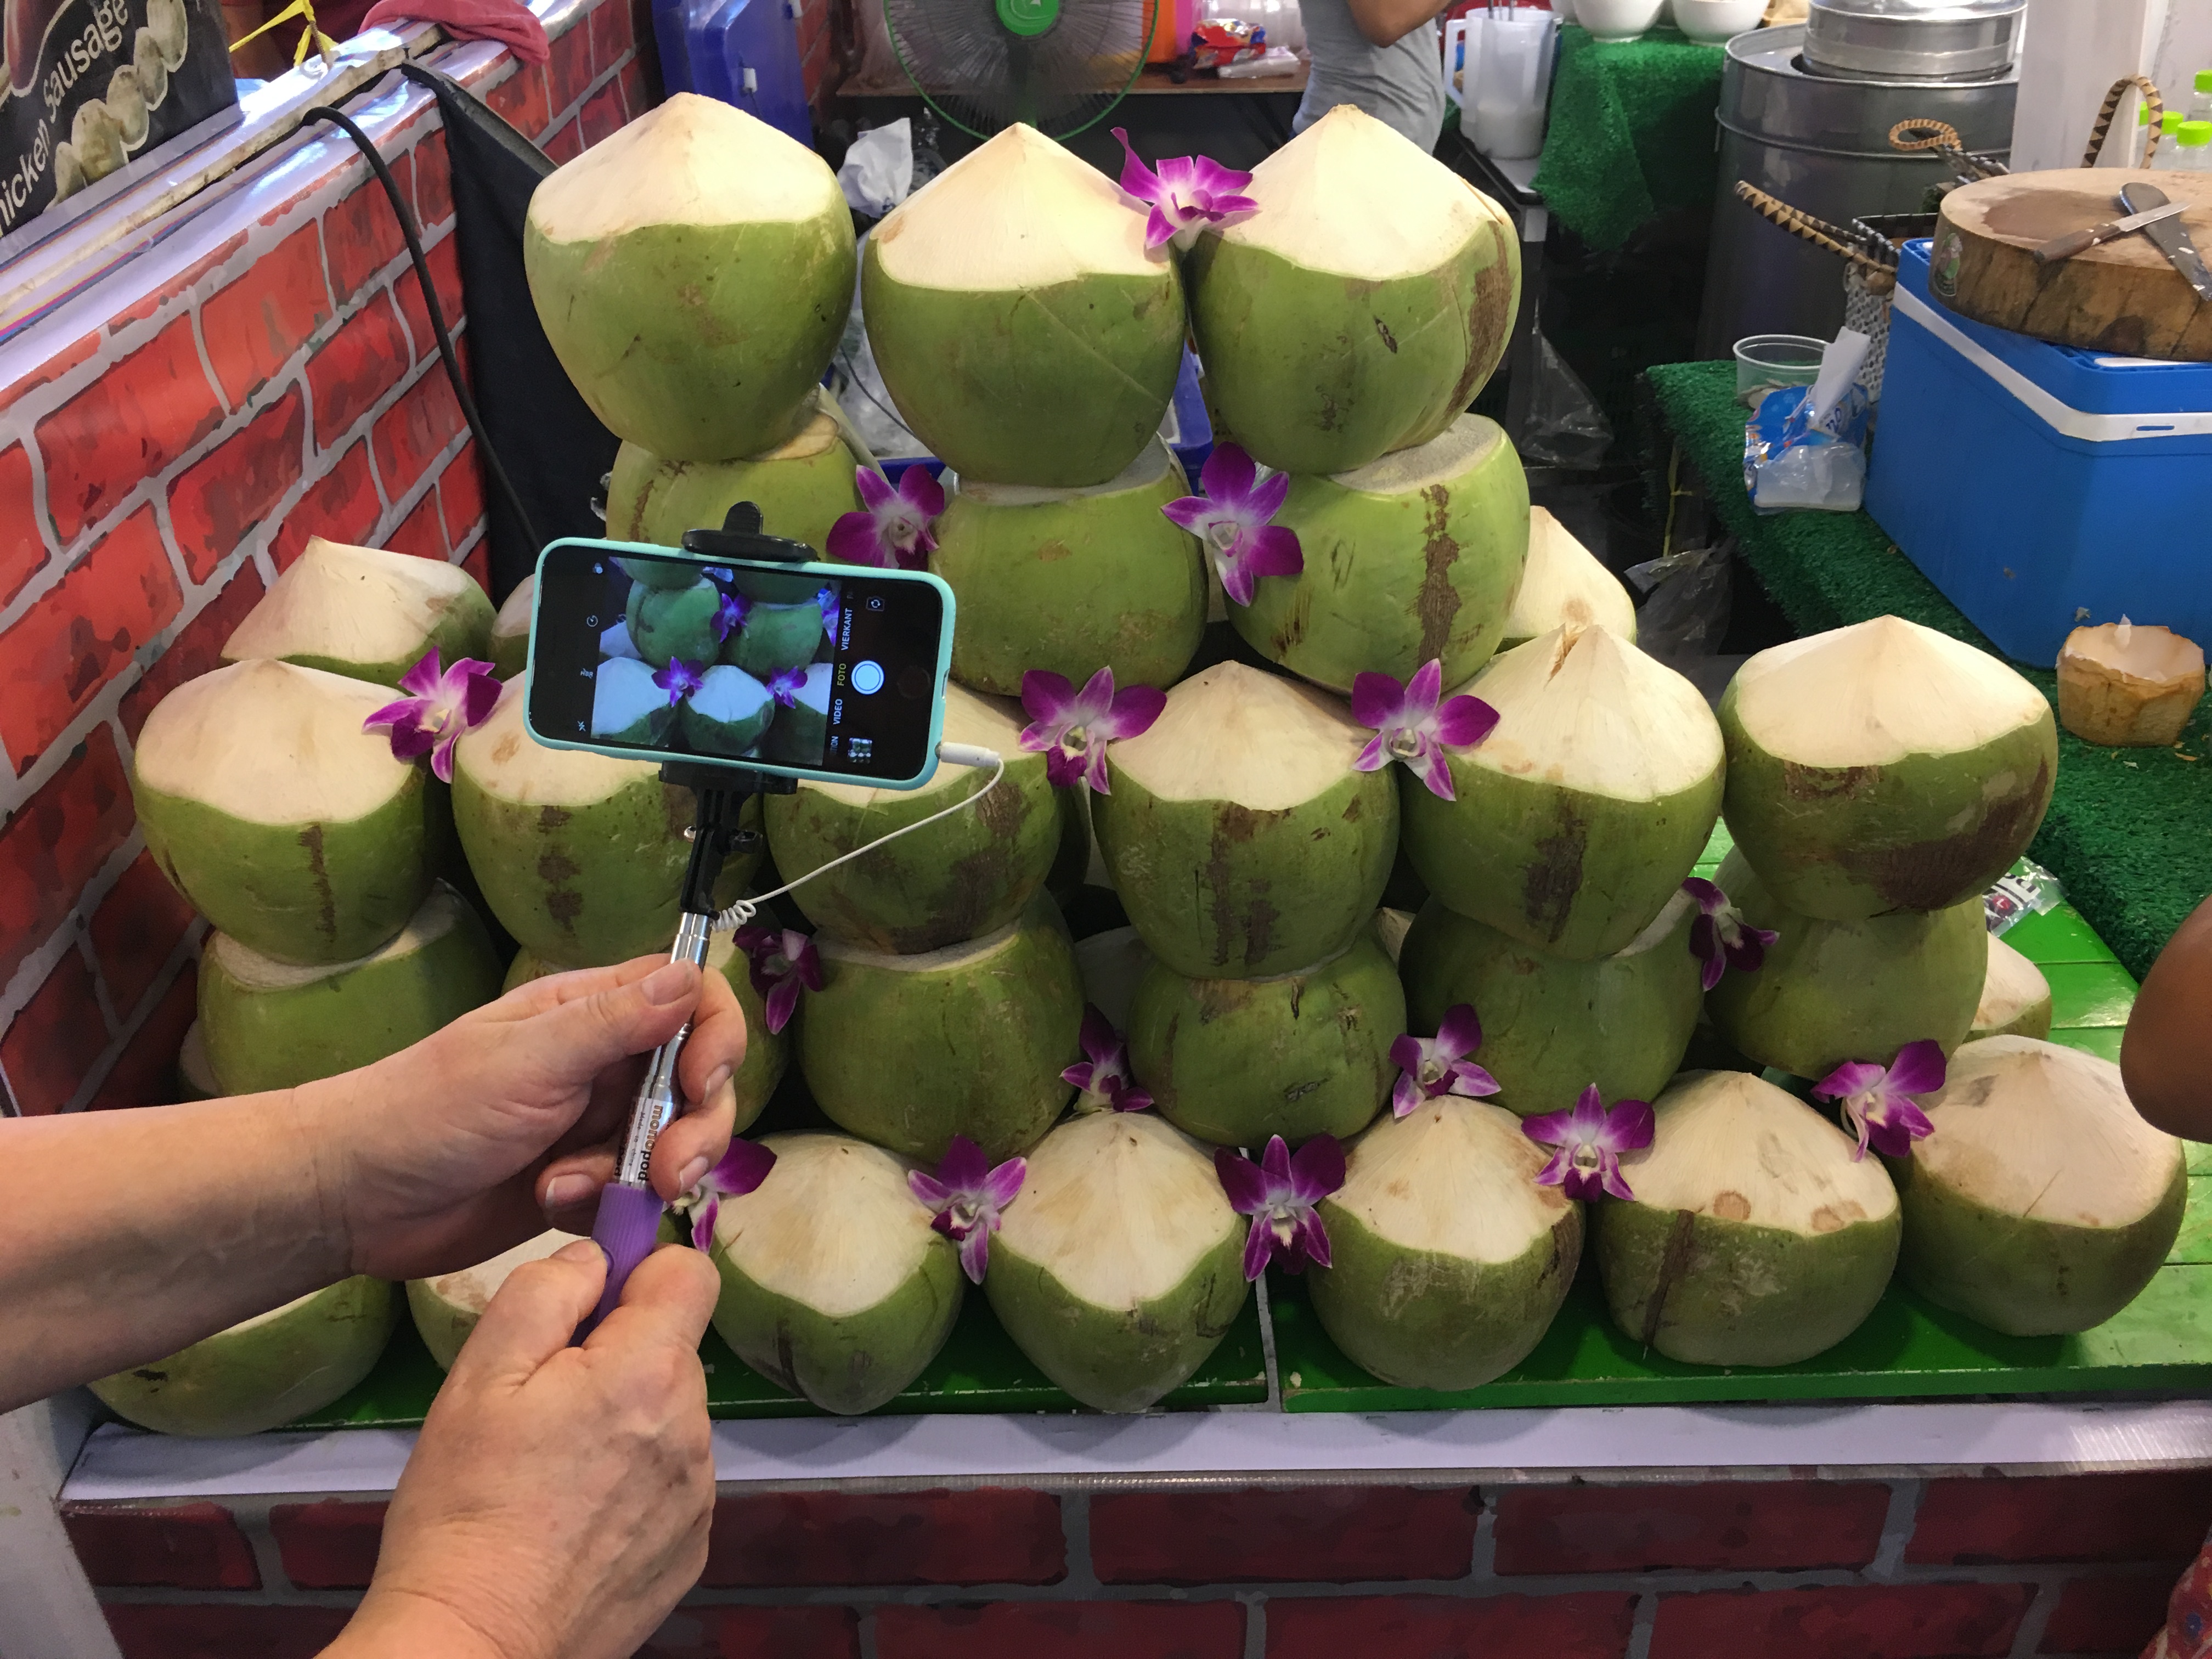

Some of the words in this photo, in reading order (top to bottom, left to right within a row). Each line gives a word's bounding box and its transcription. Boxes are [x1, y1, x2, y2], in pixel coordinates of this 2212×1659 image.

[43, 0, 128, 123] sausage
[841, 608, 853, 651] VIERKANT
[837, 663, 847, 686] FOTO
[833, 698, 843, 725] VIDEO
[637, 1105, 664, 1181] monopod
